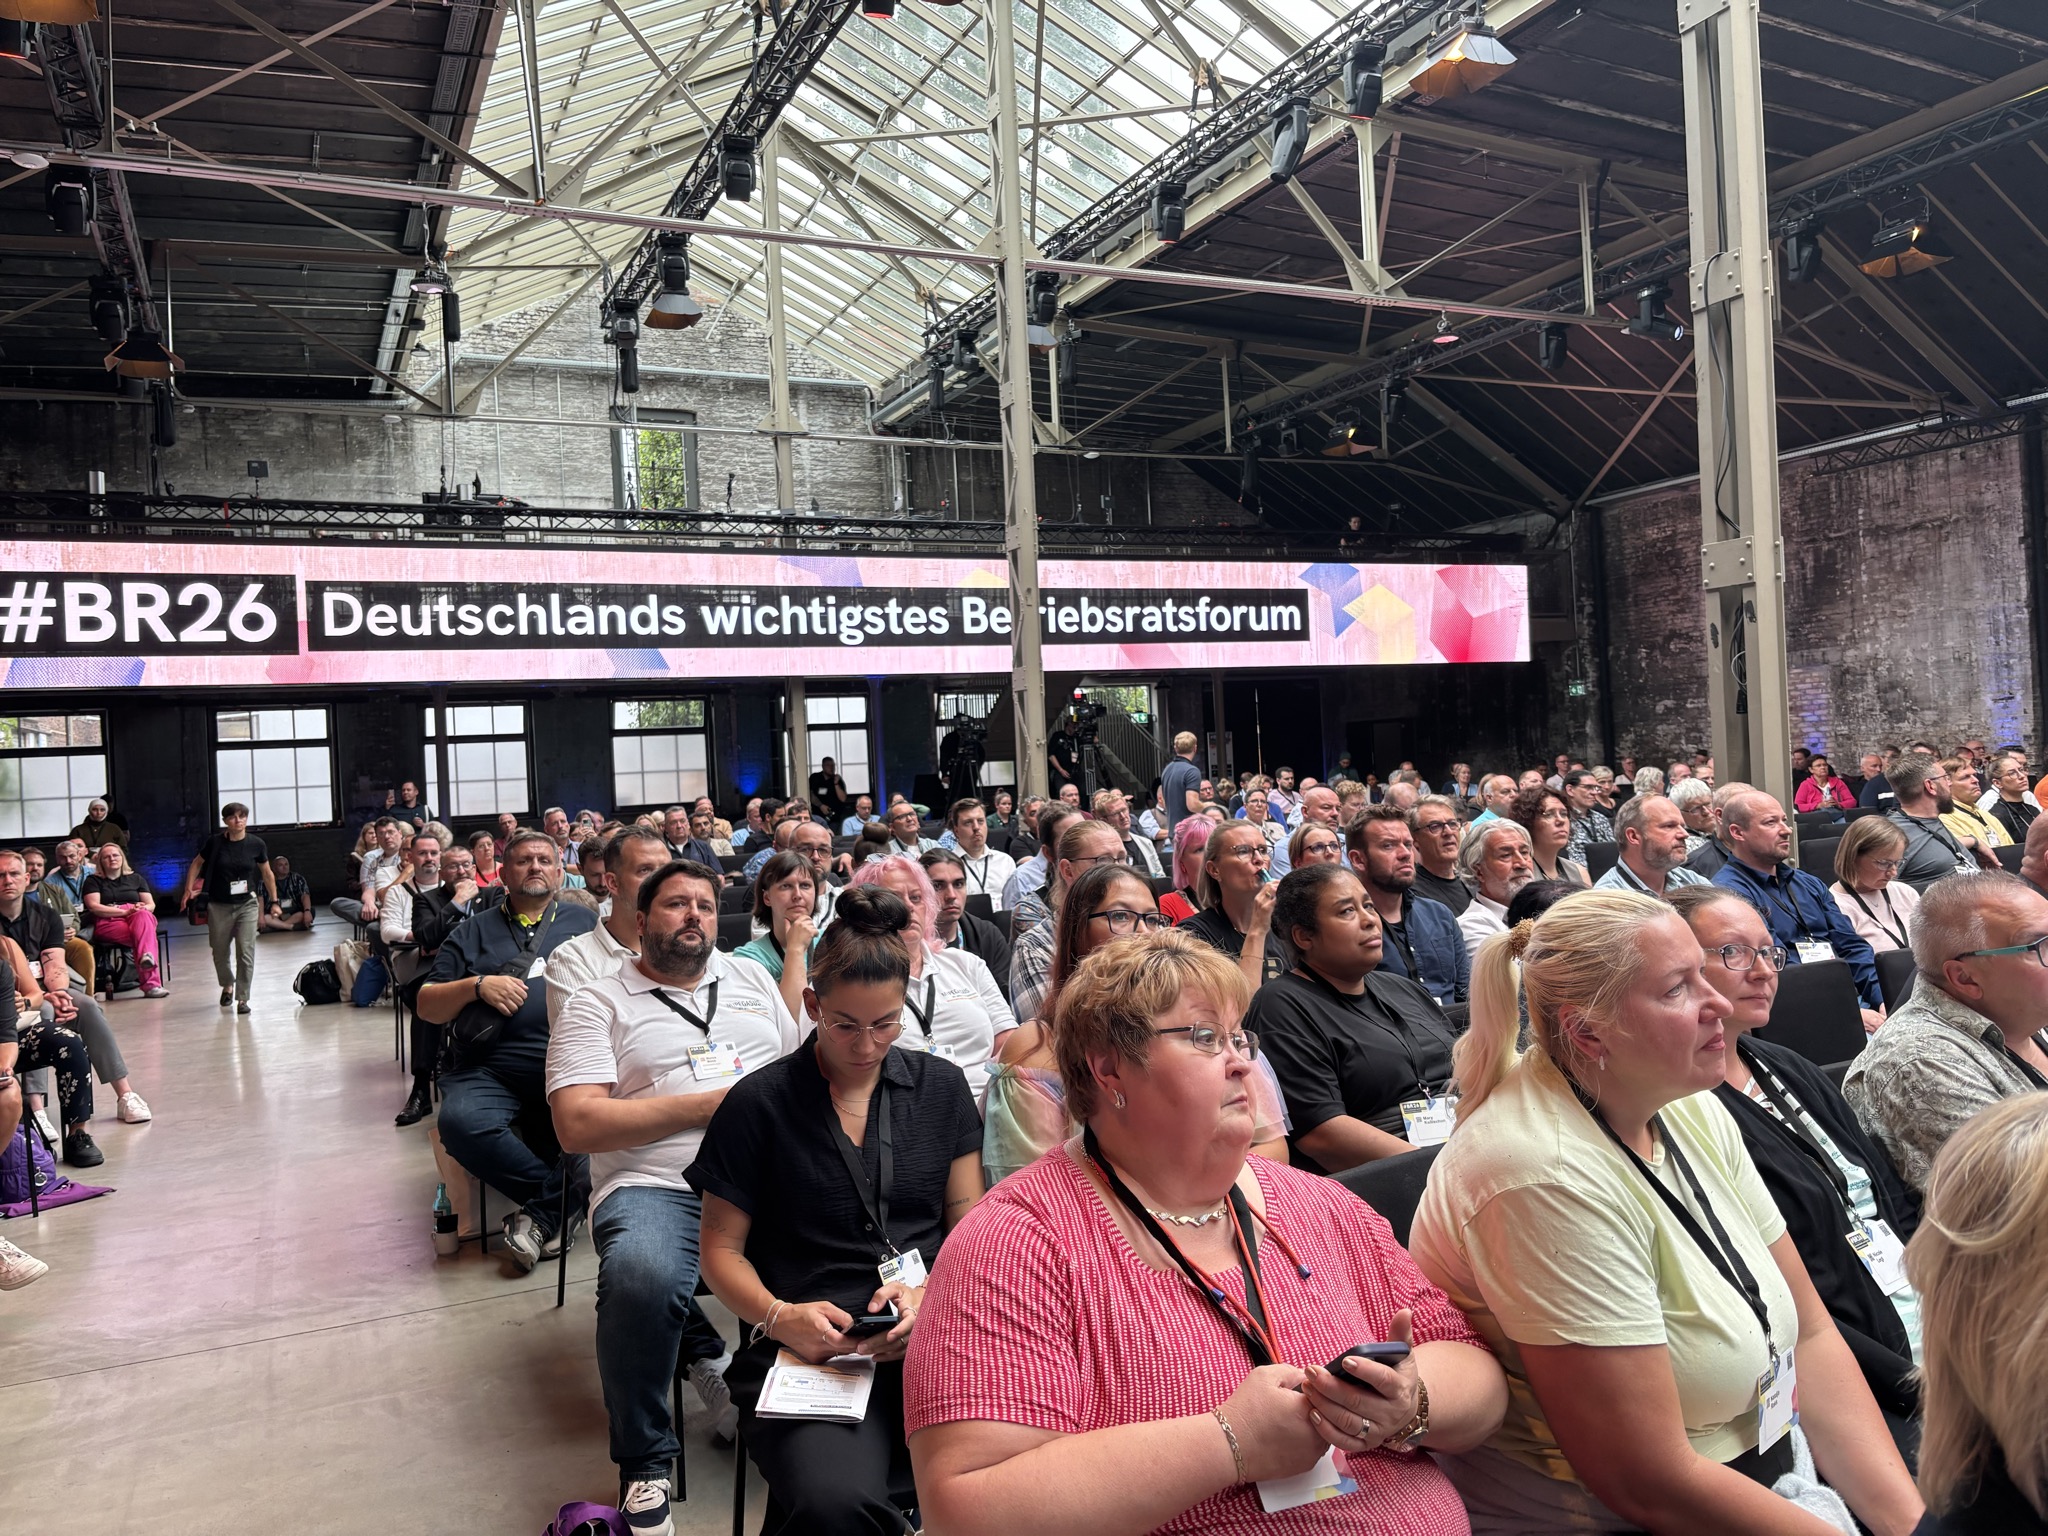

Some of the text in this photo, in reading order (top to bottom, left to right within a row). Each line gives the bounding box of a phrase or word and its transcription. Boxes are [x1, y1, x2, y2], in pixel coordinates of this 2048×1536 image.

[0, 581, 278, 644] #BR26
[322, 592, 1302, 646] Deutschlands wichtigstes Beiebsratsforum
